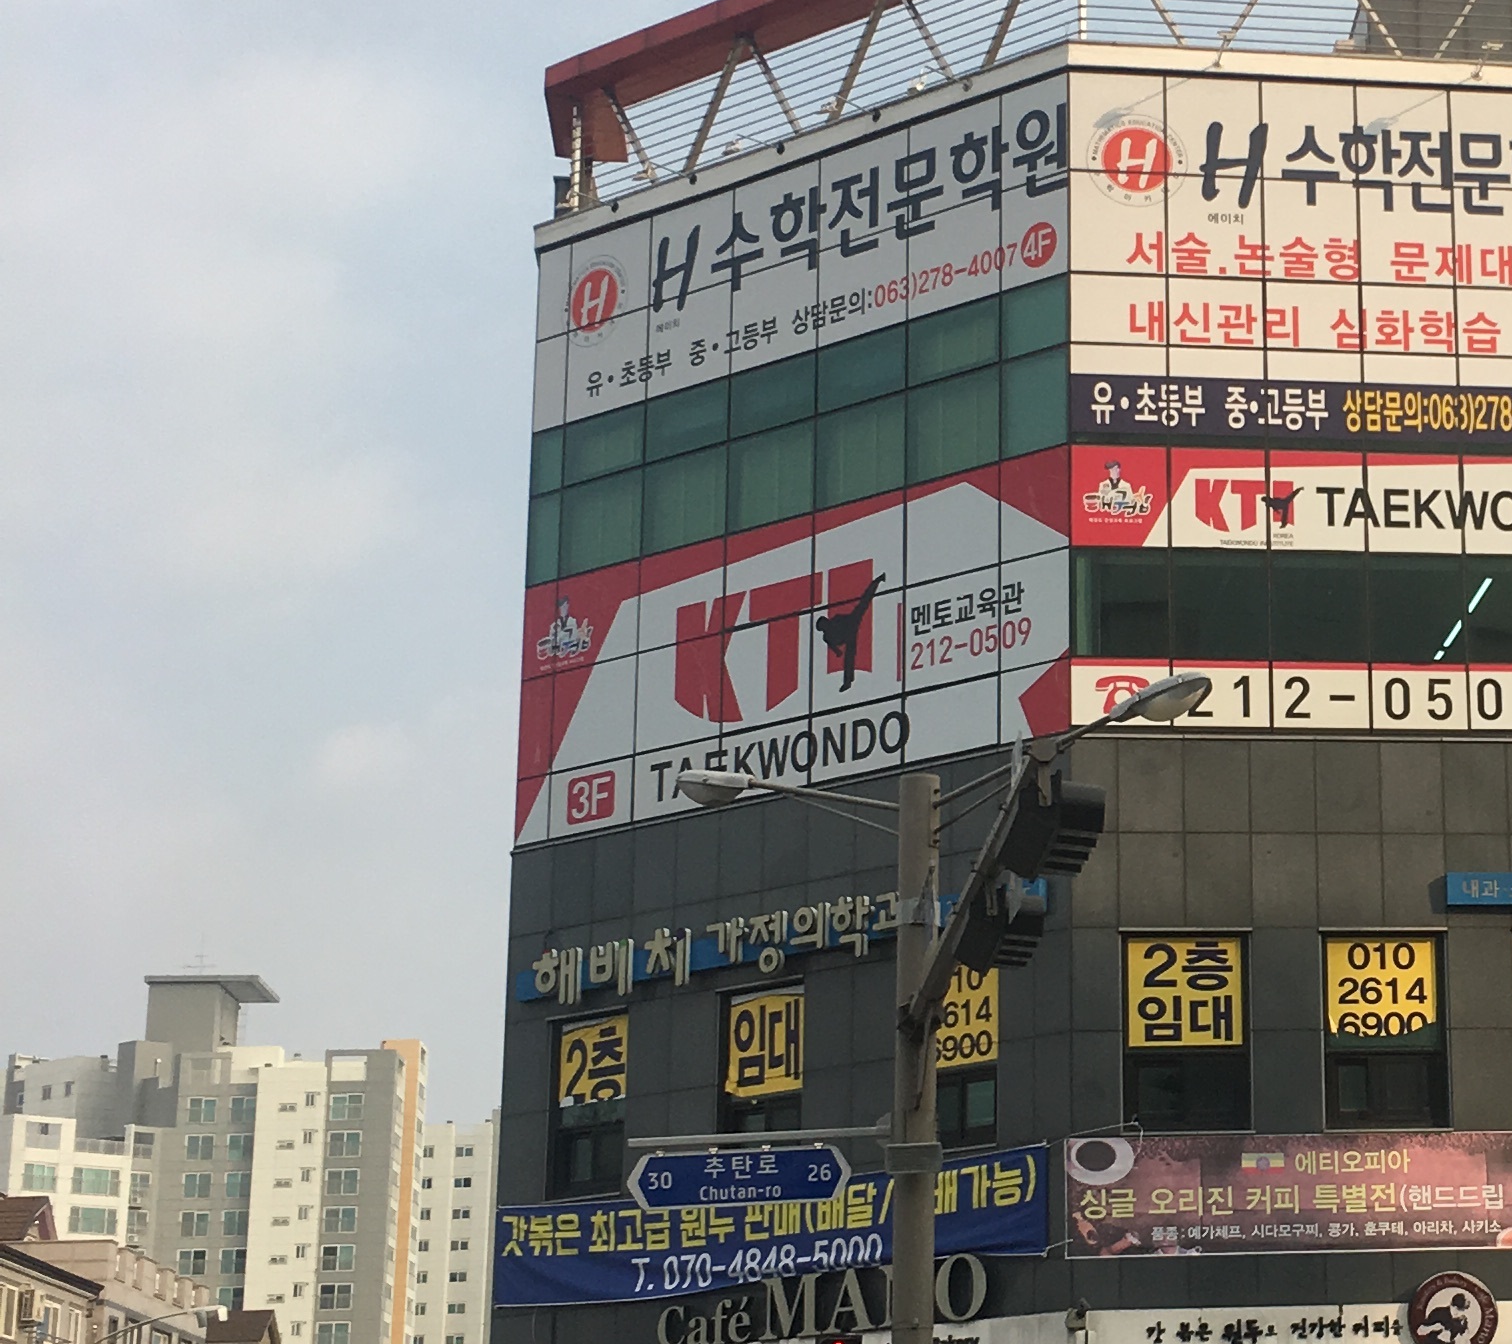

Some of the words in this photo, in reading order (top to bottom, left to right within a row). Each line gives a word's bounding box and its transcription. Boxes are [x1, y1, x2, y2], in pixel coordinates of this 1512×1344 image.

[1208, 212, 1245, 225] 에이치
[1022, 227, 1052, 263] 4F
[1128, 299, 1301, 348] 내신관리
[1330, 308, 1502, 355] 심화학습
[911, 581, 1025, 636] 멘토교육관
[911, 618, 1033, 672] 212-0509
[571, 778, 612, 821] 3F
[1143, 940, 1234, 991] 2층
[1347, 942, 1416, 971] 010
[1338, 977, 1428, 1006] 2614
[938, 995, 993, 1030] 614
[1137, 994, 1234, 1043] 임대
[734, 998, 801, 1088] 임대
[703, 1154, 780, 1181] 추탄로
[806, 1164, 832, 1183] 26
[1294, 1148, 1411, 1176] 에티오피아
[647, 1171, 674, 1191] 30
[699, 1183, 782, 1202] Chutan-ro
[1079, 1186, 1137, 1220] 싱글
[1148, 1184, 1235, 1217] 오리진
[1245, 1182, 1301, 1215] 커피
[590, 1209, 670, 1254] 최고급
[763, 1252, 987, 1340] MAO
